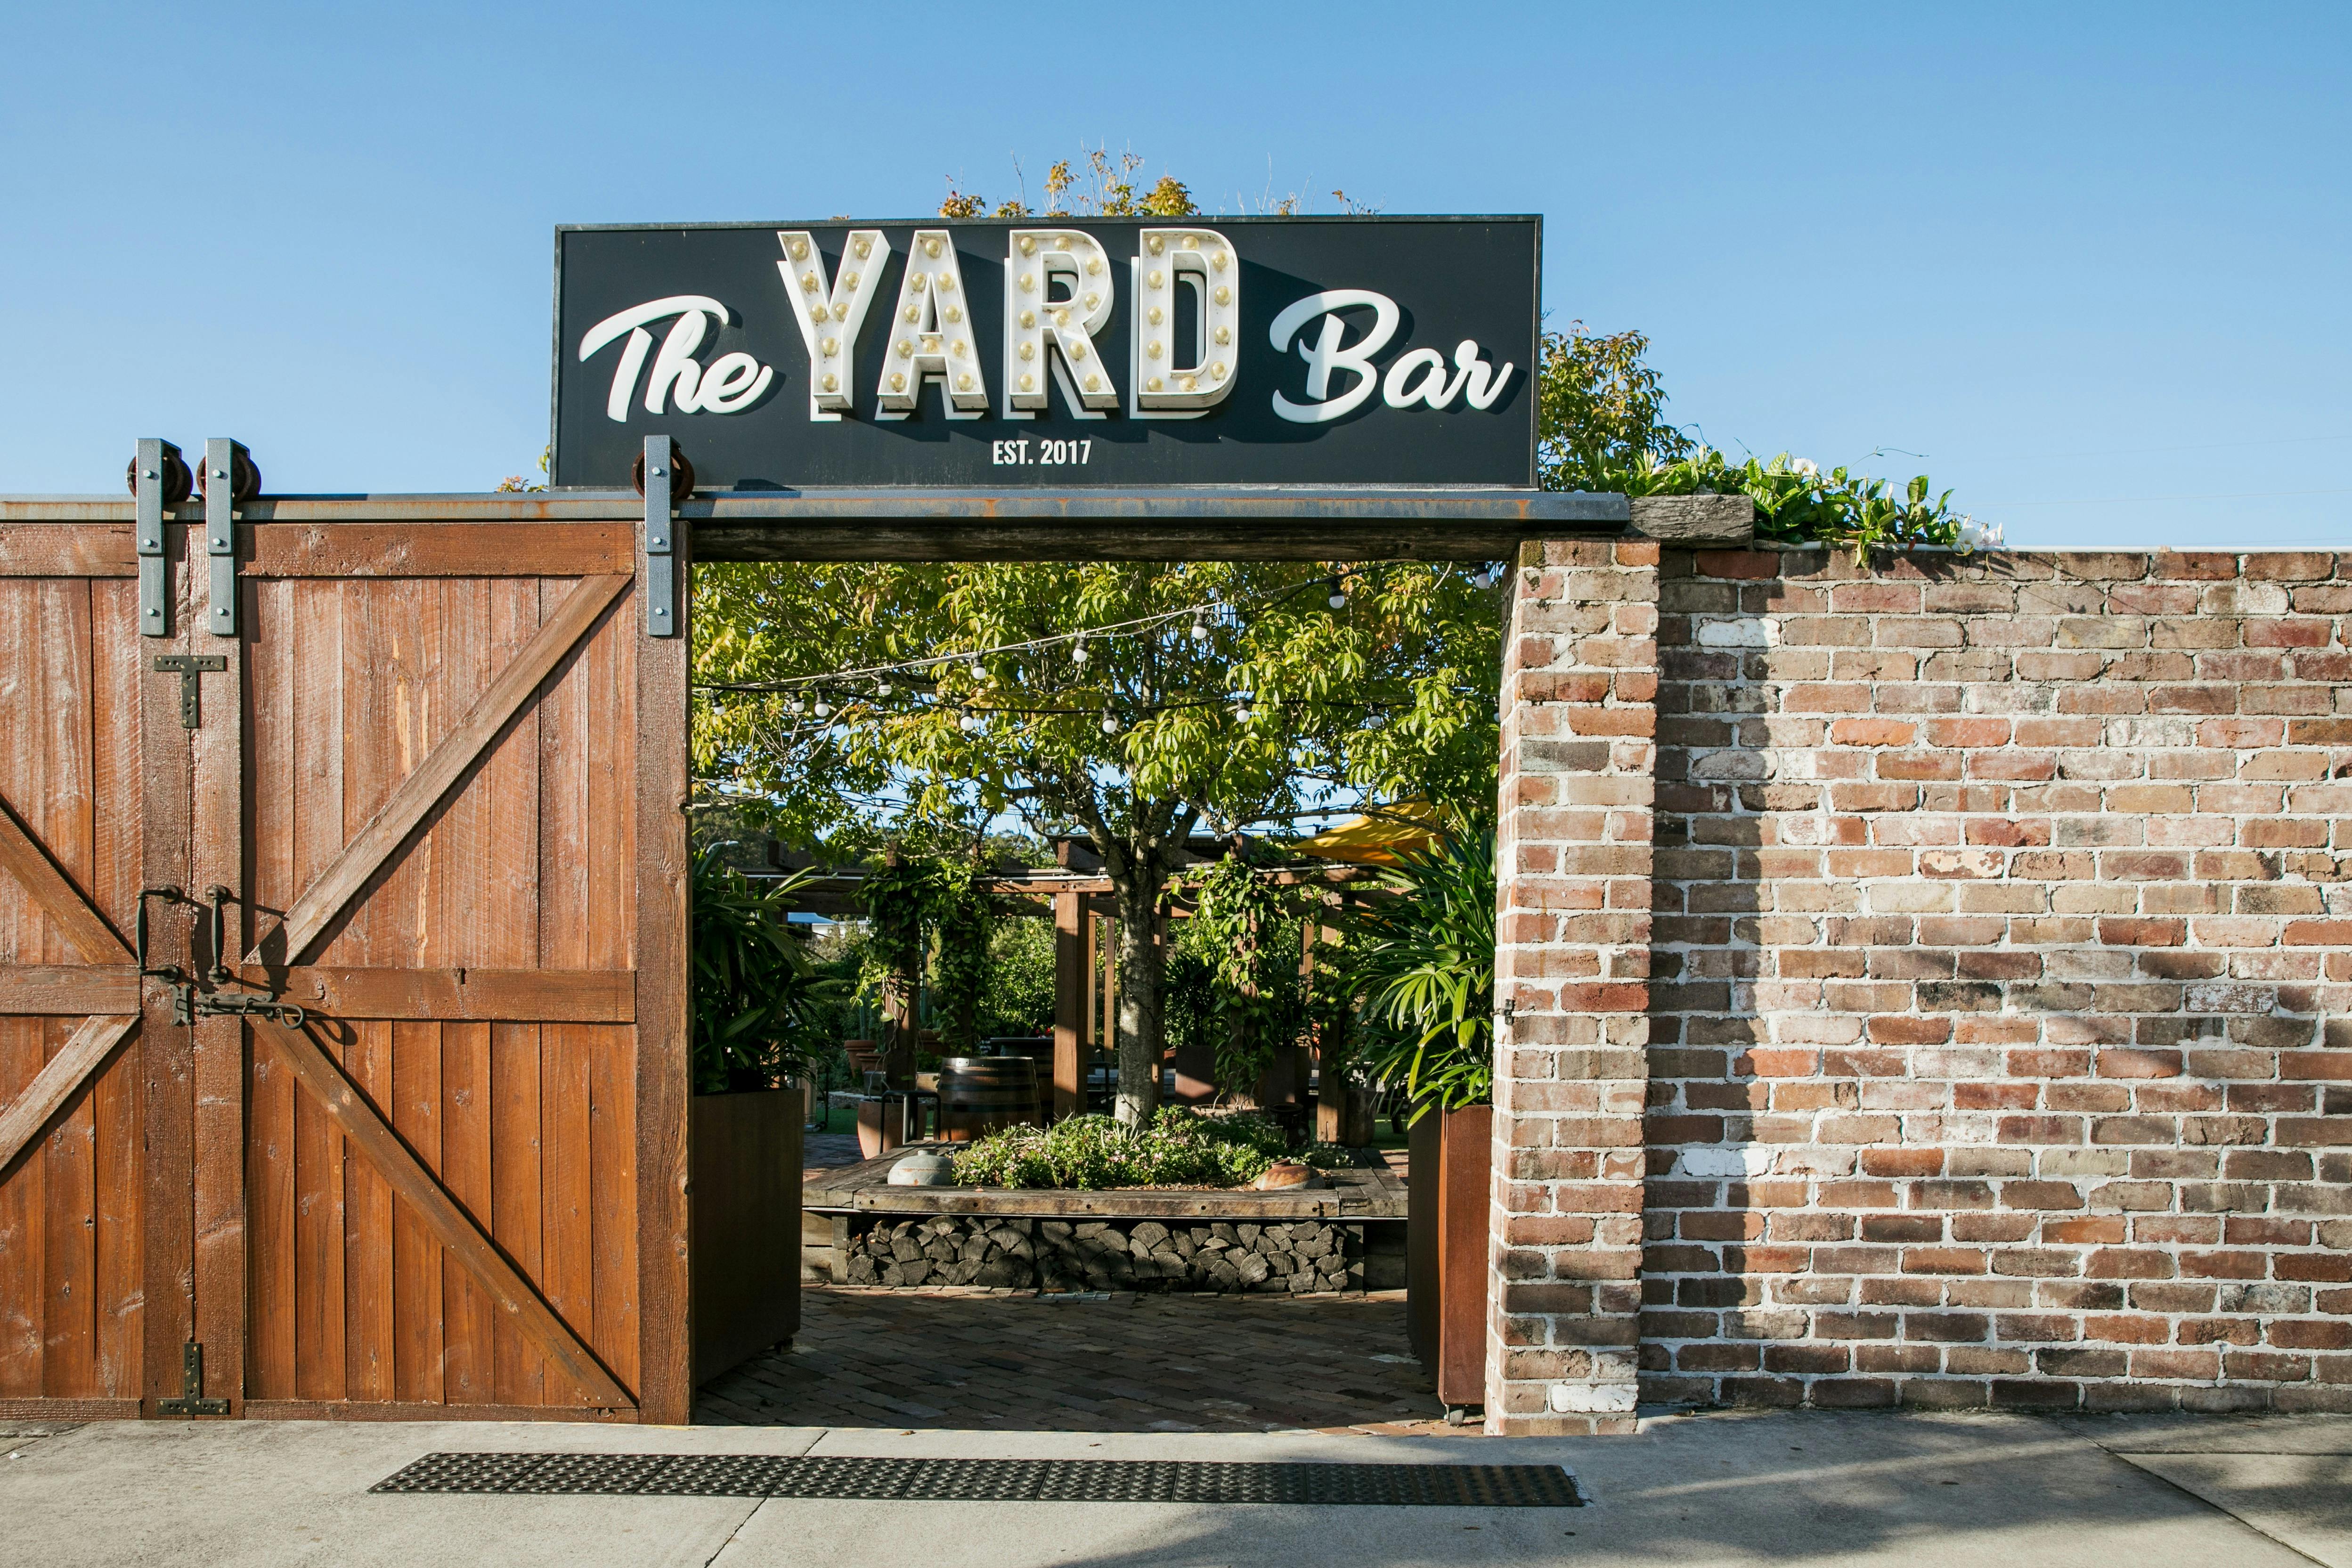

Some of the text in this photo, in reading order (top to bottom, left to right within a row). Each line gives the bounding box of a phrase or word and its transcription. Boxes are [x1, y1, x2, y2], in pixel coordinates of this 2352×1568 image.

[578, 228, 1514, 423] The YARD Bar
[993, 439, 1091, 465] EST. 2017
